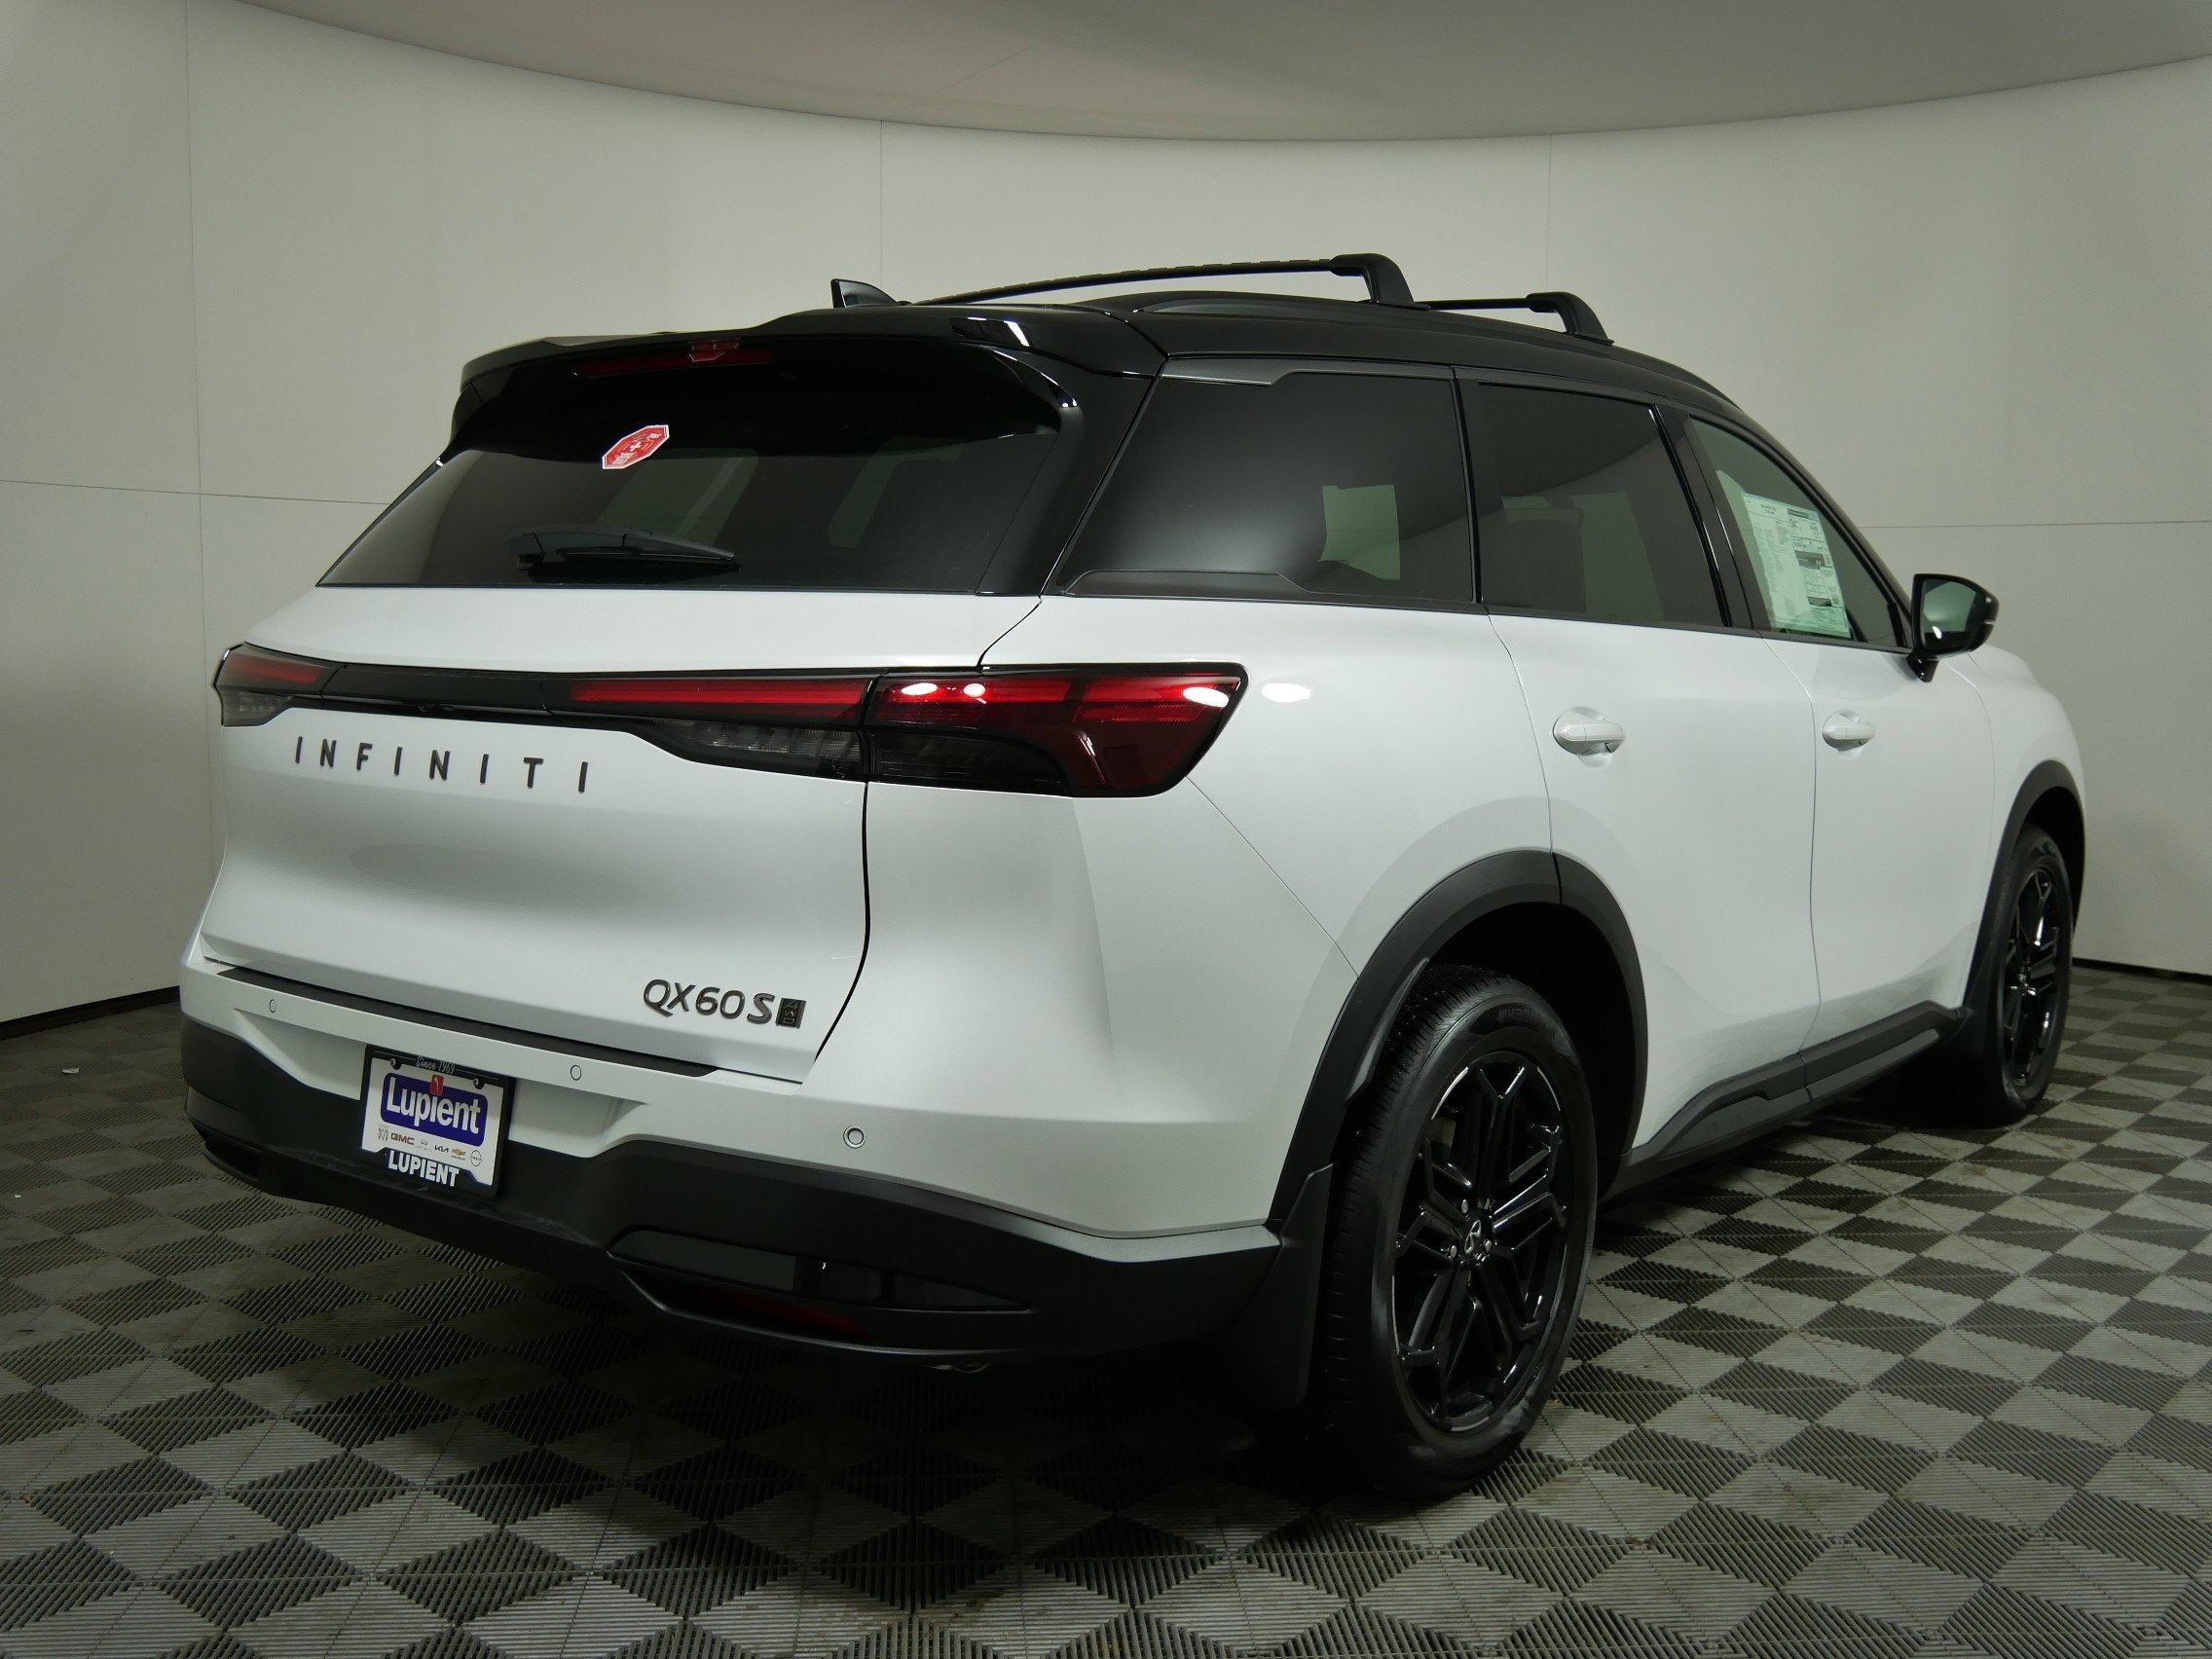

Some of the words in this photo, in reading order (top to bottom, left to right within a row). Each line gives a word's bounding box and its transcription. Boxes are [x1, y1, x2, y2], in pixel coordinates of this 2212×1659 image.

[295, 736, 588, 793] INFINITI
[387, 1077, 482, 1134] Lupient
[390, 1132, 415, 1146] GMC
[388, 1149, 460, 1188] LUPIENT
